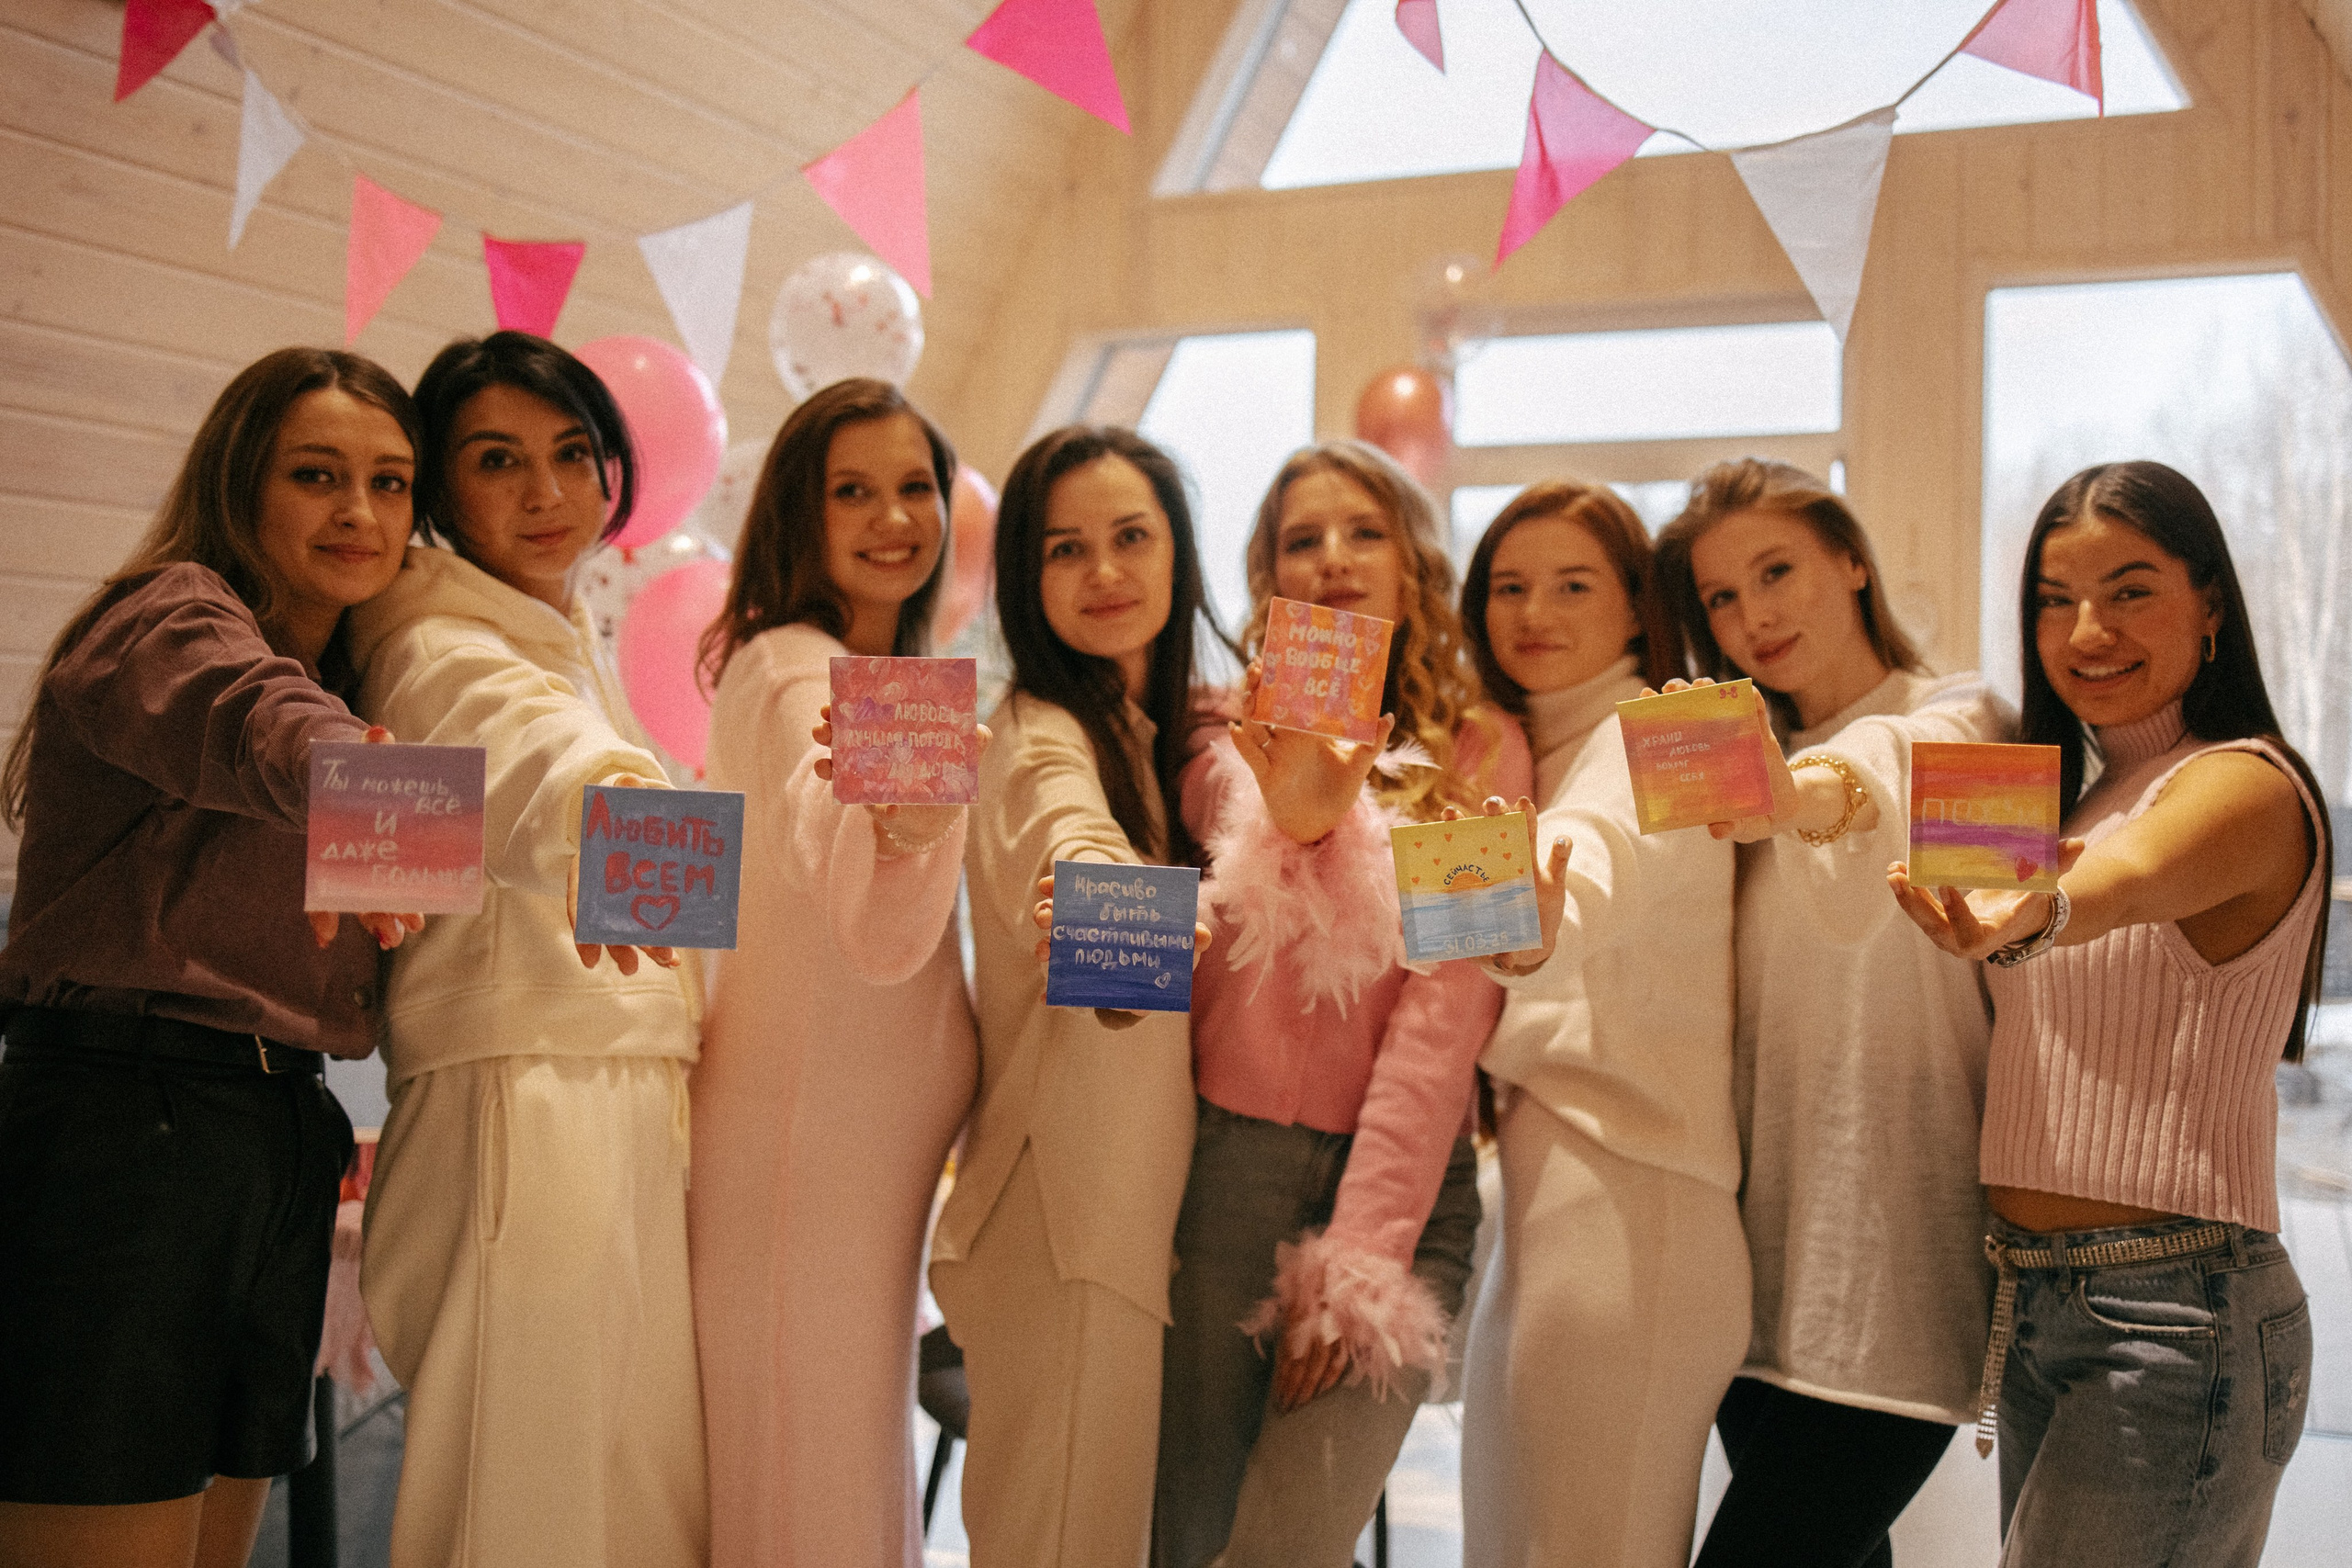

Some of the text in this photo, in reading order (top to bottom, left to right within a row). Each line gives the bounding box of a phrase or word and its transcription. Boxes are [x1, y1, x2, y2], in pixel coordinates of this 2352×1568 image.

[1288, 623, 1357, 648] МОЖНО
[1285, 646, 1362, 673] ВООБЩЕ
[1643, 731, 1682, 748] ХРАНИ
[1668, 742, 1711, 758] ЛЮБОВЬ
[322, 759, 349, 791] Ты
[362, 778, 449, 795] можешь
[375, 810, 398, 835] И
[605, 851, 715, 897] ВСЕМ
[1074, 874, 1157, 900] Красиво
[1100, 902, 1161, 922] быть
[1053, 925, 1193, 950] счастливыми
[1075, 948, 1160, 970] людьми
